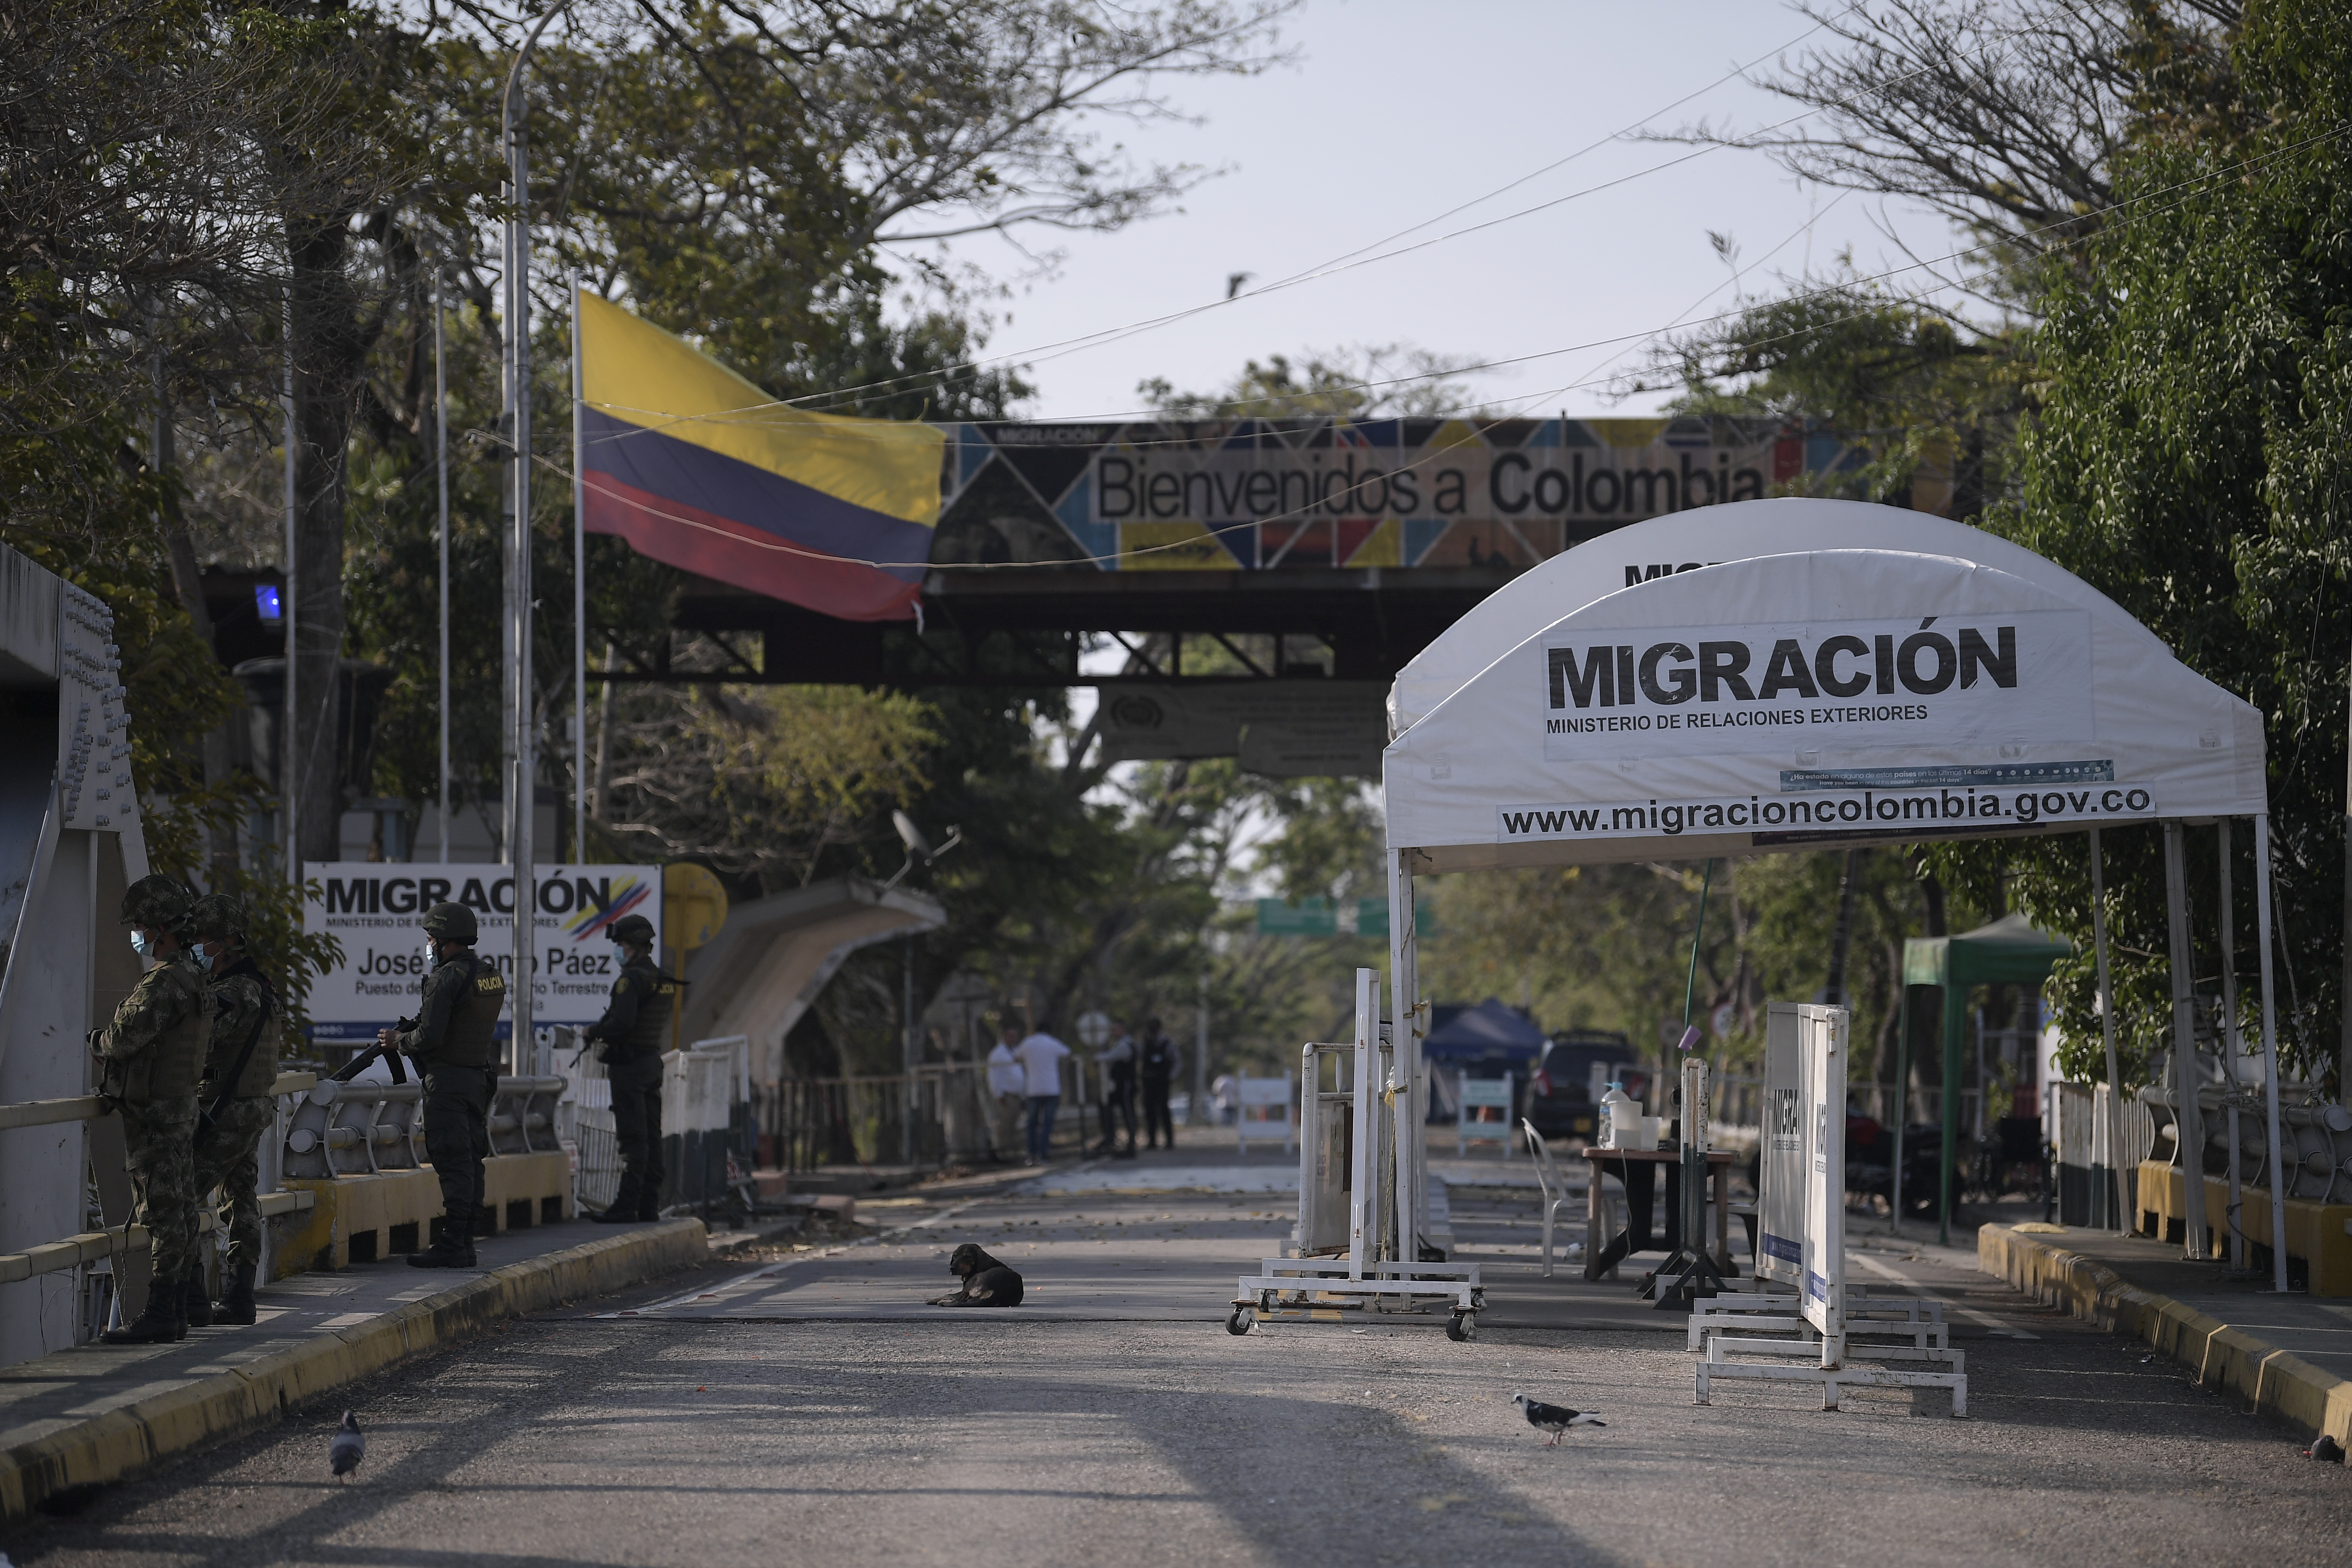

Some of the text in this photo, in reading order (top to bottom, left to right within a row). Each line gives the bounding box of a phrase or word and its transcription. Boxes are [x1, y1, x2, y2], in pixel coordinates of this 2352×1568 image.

[1100, 452, 1764, 517] Bienvenidos a Colombia
[1547, 616, 2017, 710] MIGRACIÓN
[1547, 705, 1928, 734] MINISTERIO DE RELACIONES EXTERIORES
[1501, 788, 2151, 835] www.migracioncolombia.gov.co
[327, 869, 609, 913] MIGRACÓN
[326, 918, 394, 928] MINISTERIO
[397, 918, 411, 928] DE
[359, 947, 423, 975] José
[547, 947, 610, 974] Páez
[356, 982, 401, 995] Puesto
[406, 981, 422, 995] de
[552, 981, 608, 994] Terrestre
